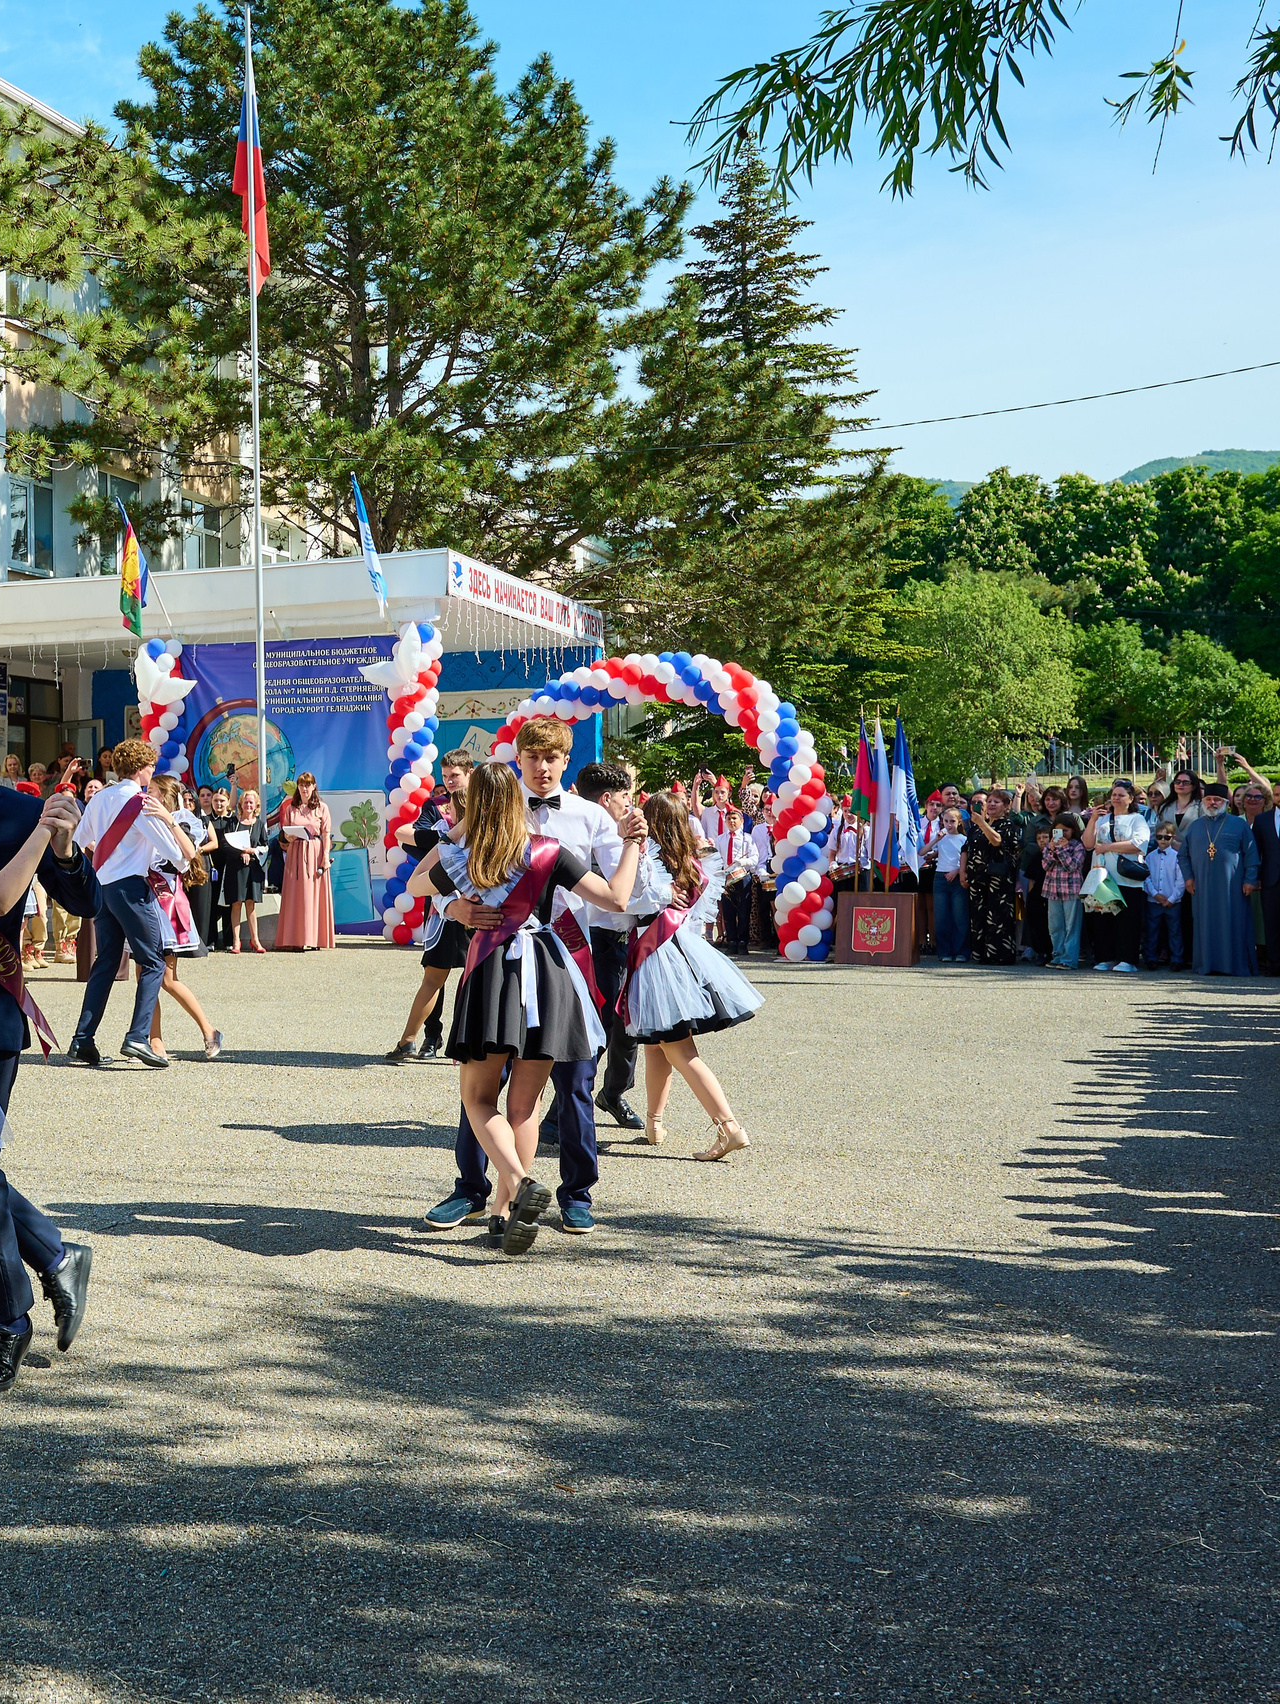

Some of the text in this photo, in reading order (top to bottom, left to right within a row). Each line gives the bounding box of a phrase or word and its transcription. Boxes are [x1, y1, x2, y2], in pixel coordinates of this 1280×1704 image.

[468, 566, 491, 600] ЗДЕСЬ
[494, 578, 537, 616] НАЧИНАЕТСЯ
[540, 595, 554, 622] ВАШ
[556, 601, 571, 628] ПУТЬ
[573, 608, 578, 631] К
[265, 647, 378, 659] МУНИЦИПАЛЬНОЕ БЮДЖЕТНОЕ
[252, 657, 341, 668] ОЩЕОБРАЗОВАТЕЛЬНОЕ
[264, 676, 367, 687] РЕДНЯЯ ОБЩЕОБРАЗОВАТЕЛ
[264, 688, 282, 696] КОЛА
[283, 687, 295, 695] №7
[296, 687, 323, 695] ИМЕНИ
[324, 686, 339, 694] П.Д.
[265, 694, 383, 704] УНИЦИПАЛЬНОГО ОБРАЗОВАНИЯ
[271, 704, 372, 714] ГОРОД-КУРОРТ ГЕЛЕНДЖИК
